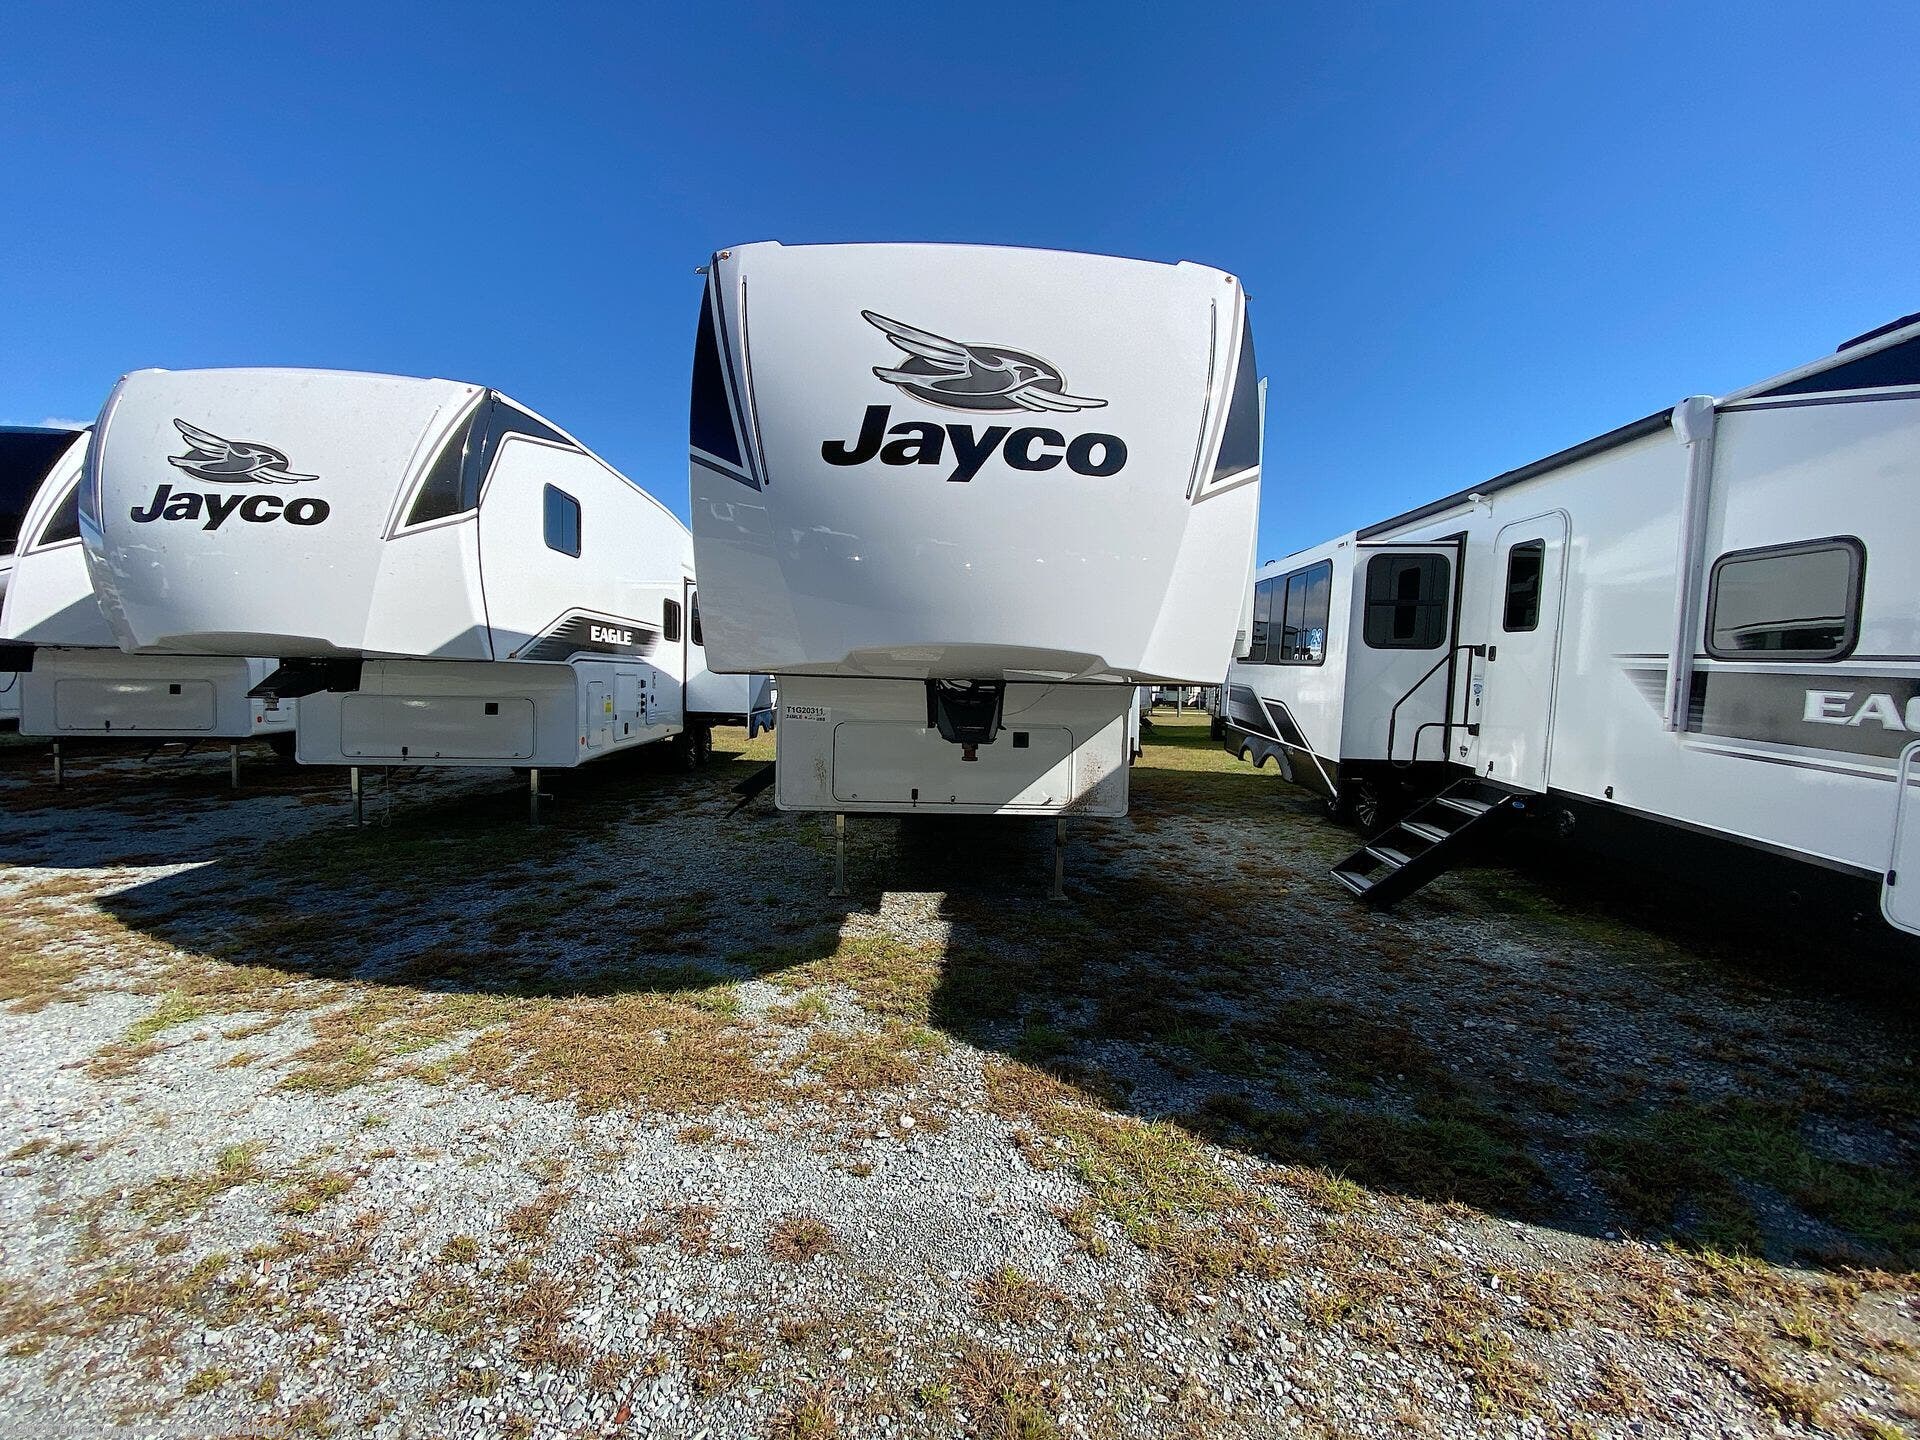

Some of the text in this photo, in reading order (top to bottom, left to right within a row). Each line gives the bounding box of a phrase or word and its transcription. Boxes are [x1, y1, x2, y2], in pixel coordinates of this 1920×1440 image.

[821, 404, 1128, 483] Jayco
[130, 484, 331, 531] Jayco
[590, 625, 633, 646] EAGLE
